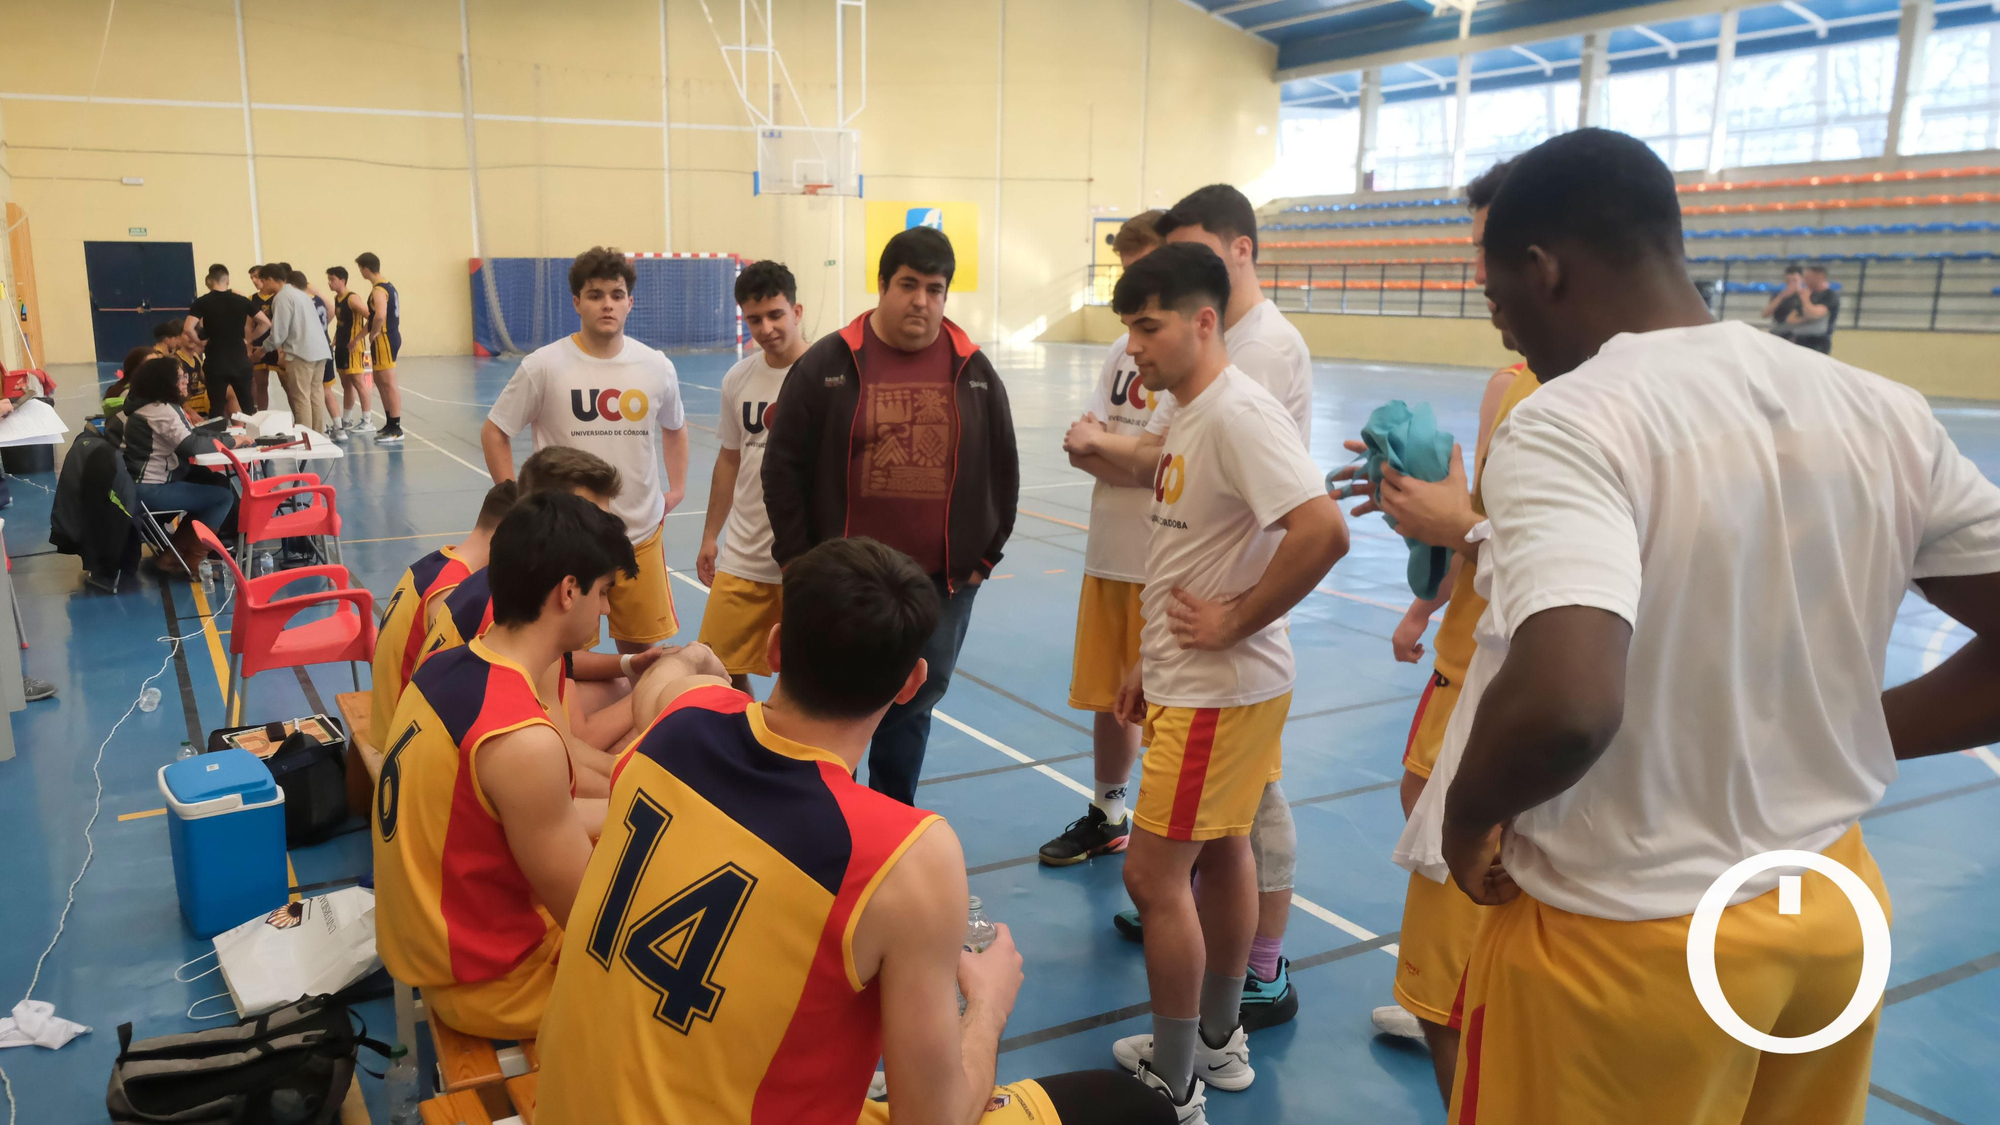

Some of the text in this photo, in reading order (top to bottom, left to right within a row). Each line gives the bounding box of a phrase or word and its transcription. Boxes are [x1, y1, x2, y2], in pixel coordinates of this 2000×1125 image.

[571, 388, 649, 422] UCO
[623, 428, 649, 436] CÓRDOBA
[1155, 453, 1186, 505] CO
[377, 720, 422, 843] 6
[586, 787, 758, 1036] 14
